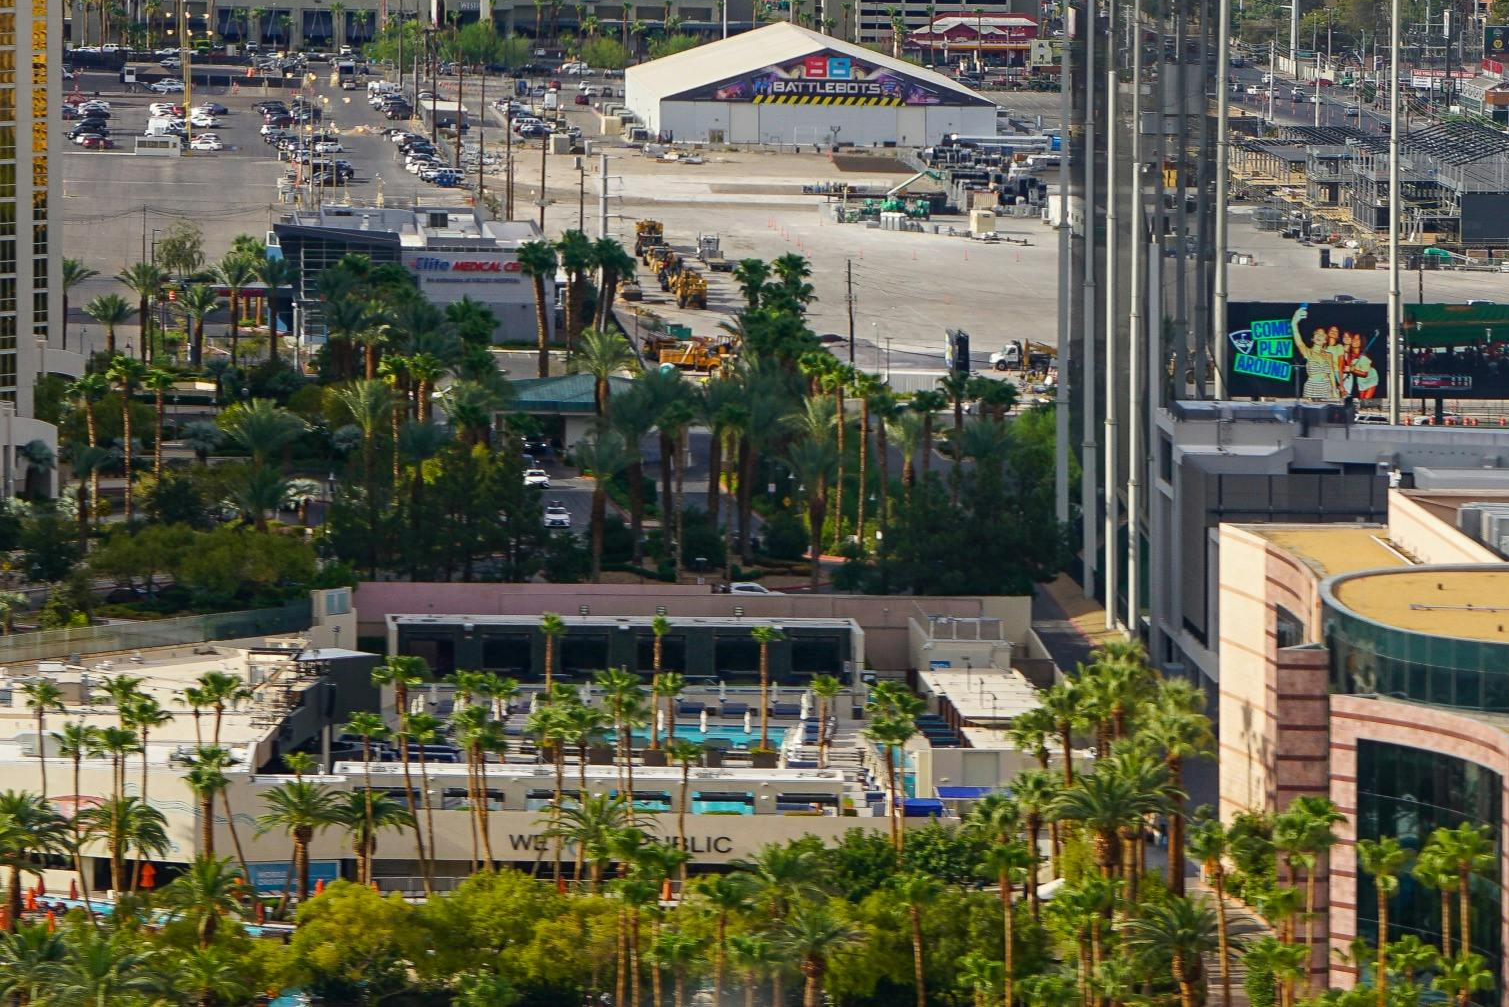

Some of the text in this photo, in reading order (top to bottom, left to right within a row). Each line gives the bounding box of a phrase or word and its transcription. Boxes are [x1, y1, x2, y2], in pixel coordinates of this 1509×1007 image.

[773, 81, 881, 94] BATTLEBOTS
[415, 257, 450, 271] Elite
[452, 261, 502, 272] MEDICAL
[1253, 321, 1293, 338] COME
[1260, 341, 1291, 356] PLAY
[1237, 355, 1290, 379] AROUND
